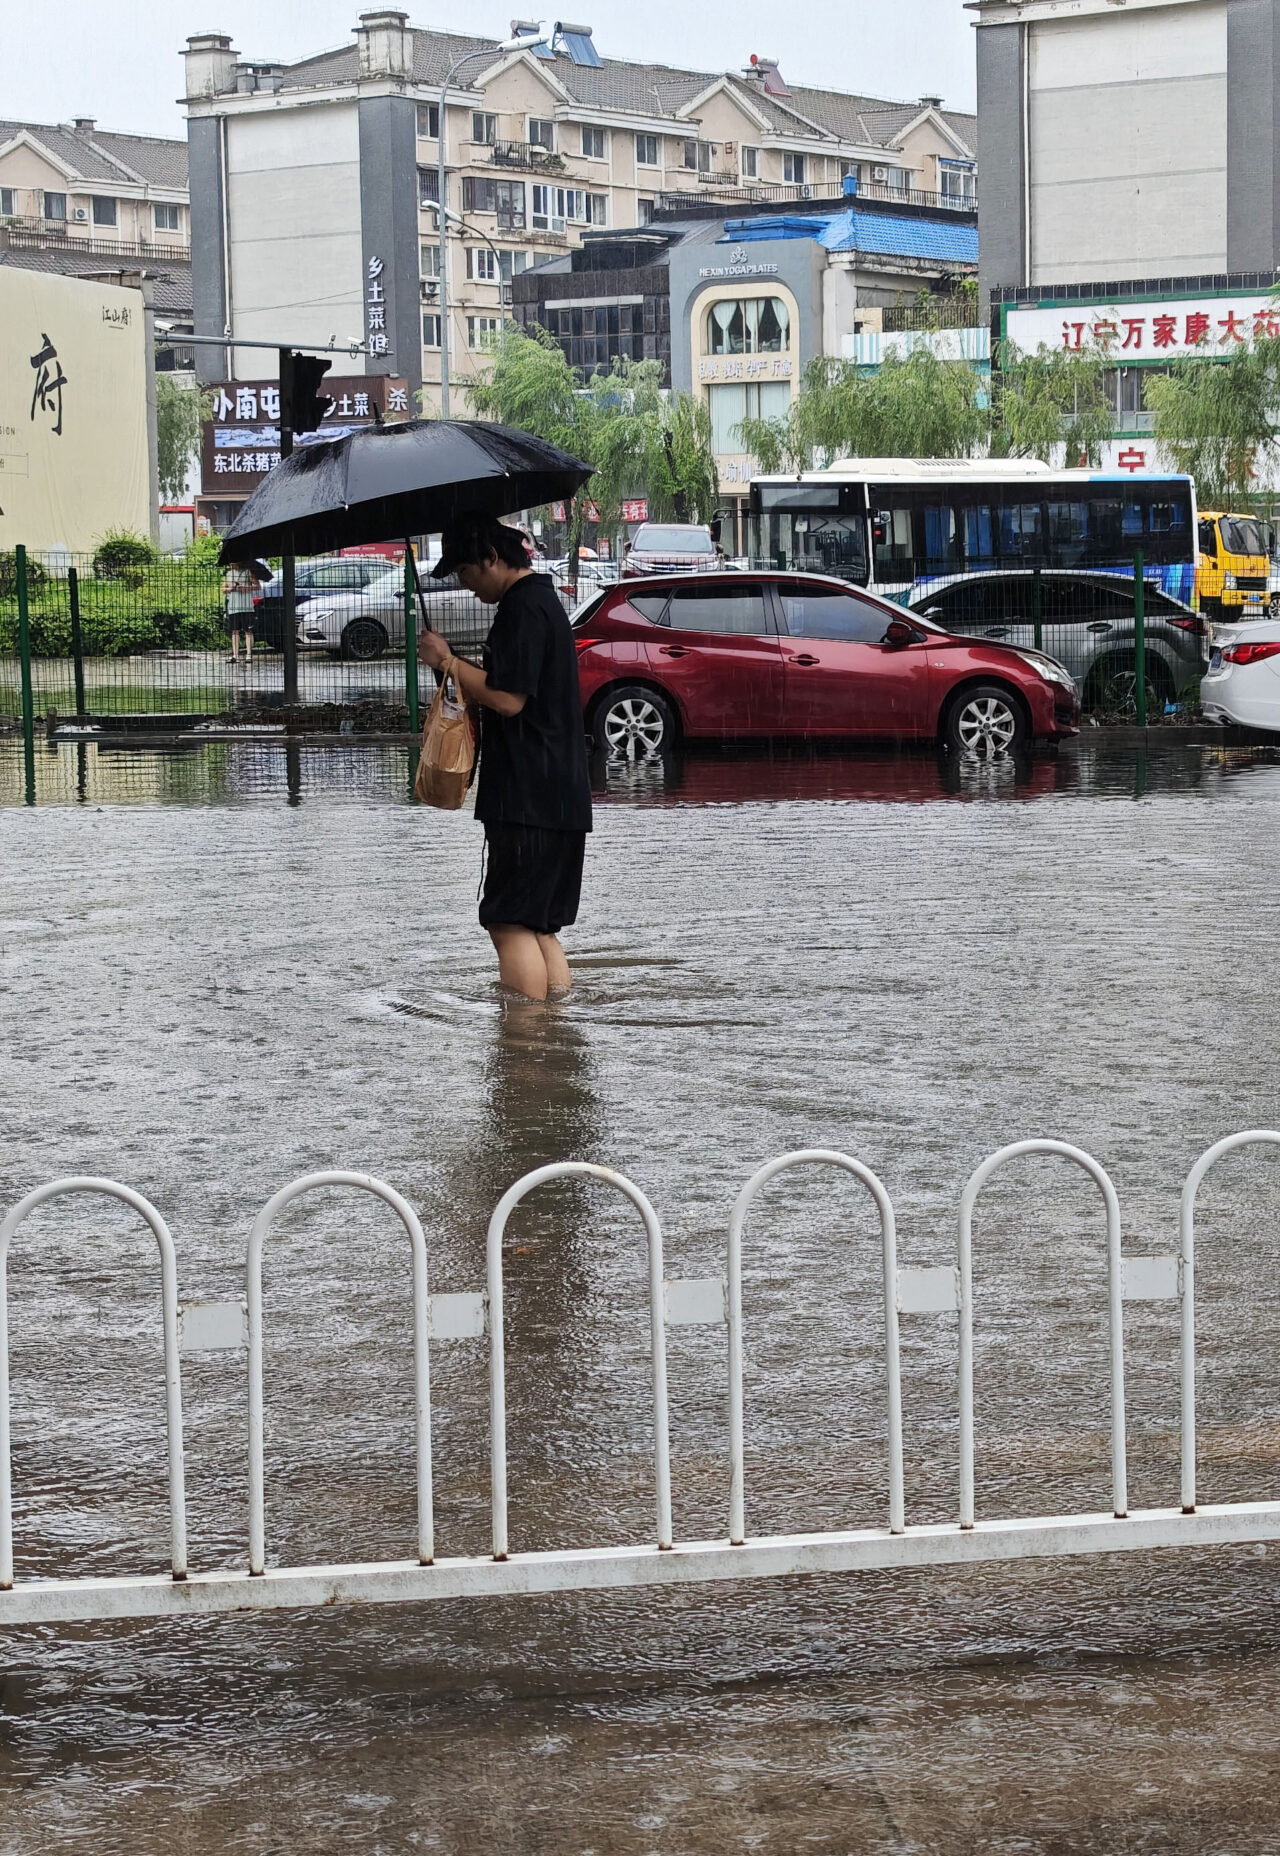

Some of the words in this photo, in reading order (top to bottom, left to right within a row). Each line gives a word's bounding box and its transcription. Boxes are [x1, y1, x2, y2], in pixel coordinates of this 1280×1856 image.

[699, 267, 723, 278] HEXIN
[367, 255, 389, 359] 乡土菜馆
[30, 332, 68, 437] 府
[213, 452, 283, 474] 东北杀猪菜
